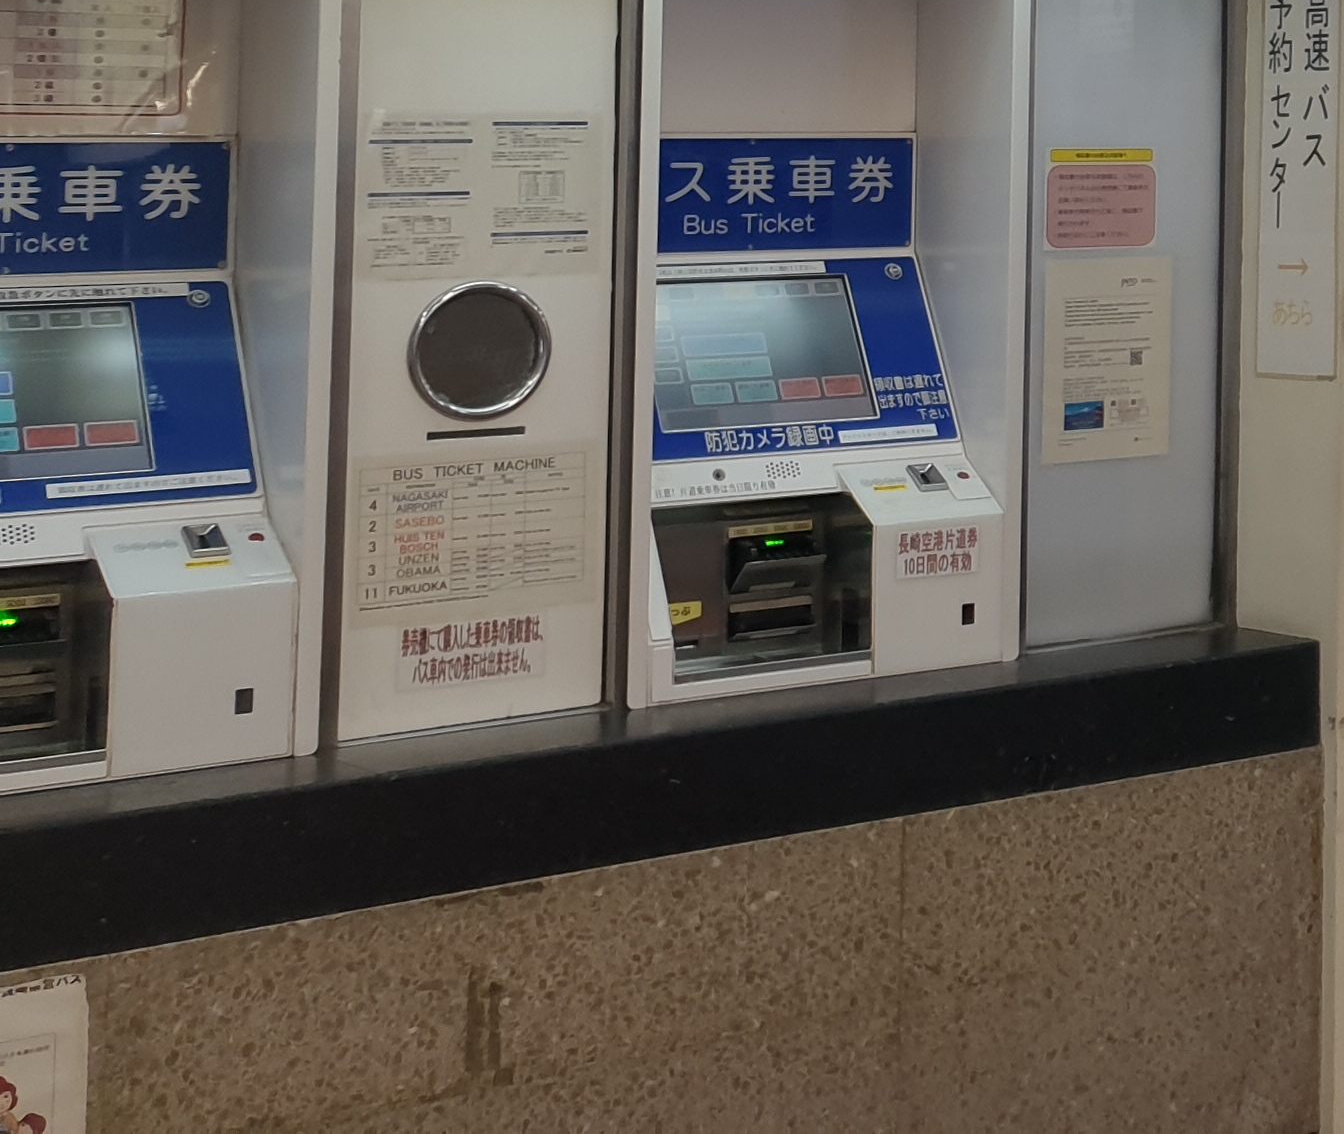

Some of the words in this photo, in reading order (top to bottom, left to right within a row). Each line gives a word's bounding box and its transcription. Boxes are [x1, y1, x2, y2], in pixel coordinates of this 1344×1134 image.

[665, 154, 893, 206] ス乗車券
[0, 163, 201, 222] 乗車券
[683, 215, 728, 235] Bus
[741, 213, 815, 234] Ticket
[0, 232, 89, 254] Ticket
[918, 407, 950, 421] 下さい
[704, 424, 835, 454] 防犯カメラ録画中
[393, 468, 423, 481] BUS
[434, 463, 483, 477] TICKET
[494, 457, 556, 472] MACHINE
[393, 490, 448, 502] NAGASAKI
[396, 501, 443, 514] AIRPORT
[395, 516, 444, 529] SASEBO
[394, 533, 421, 544] HUIS
[425, 531, 445, 542] TEN
[898, 527, 978, 555] 長崎空港片道券
[400, 543, 438, 554] BOSCH
[399, 553, 440, 565] UNZEN
[903, 552, 972, 576] 10日間の有効
[396, 565, 441, 578] OBAMA
[388, 581, 447, 597] FUKUOKA
